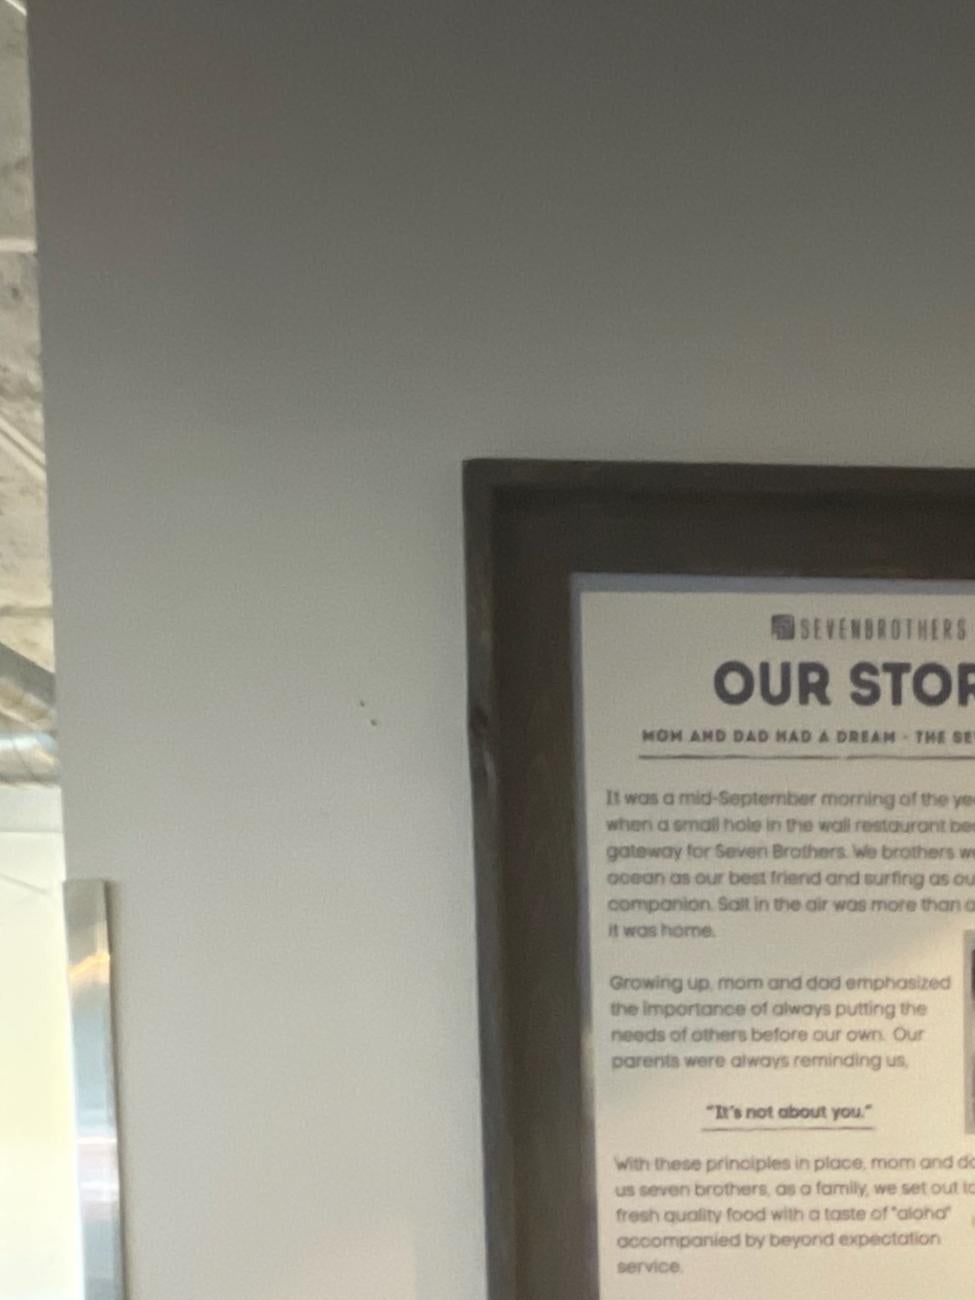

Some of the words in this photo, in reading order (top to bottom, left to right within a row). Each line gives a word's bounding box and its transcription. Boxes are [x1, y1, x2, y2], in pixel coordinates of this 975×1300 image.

[801, 617, 967, 641] SEVENBROTHERS
[714, 661, 831, 706] OUR
[642, 729, 683, 742] MOM
[690, 729, 726, 742] AND
[733, 730, 769, 743] DAD
[776, 730, 812, 743] HAD
[818, 730, 830, 743] A
[836, 730, 896, 743] DREAM
[916, 730, 945, 744] THE
[606, 790, 620, 806] It
[624, 793, 659, 805] was
[663, 793, 675, 805] a
[678, 790, 816, 810] mid-September
[821, 792, 896, 811] morning
[899, 791, 917, 806] of
[920, 792, 949, 807] the
[606, 845, 682, 863] gateway
[686, 844, 711, 859] for
[714, 843, 768, 859] Seven
[852, 845, 878, 859] We
[881, 845, 955, 860] brothers
[607, 872, 666, 885] ocean
[669, 873, 691, 885] as
[694, 872, 724, 885] our
[728, 871, 767, 885] best
[770, 871, 822, 886] friend
[825, 871, 861, 886] and
[864, 871, 925, 890] surfing
[929, 873, 950, 886] as
[609, 975, 683, 994] Growing
[718, 977, 764, 990] mom
[767, 976, 803, 990] and
[806, 976, 841, 991] dad
[845, 976, 951, 996] emphasized
[610, 1002, 639, 1016] the
[642, 1000, 746, 1020] importance
[750, 1001, 768, 1016] of
[772, 1002, 831, 1020] always
[835, 1001, 896, 1020] putting
[900, 1002, 927, 1016] the
[611, 1028, 666, 1043] needs
[669, 1027, 688, 1042] of
[691, 1028, 747, 1042] others
[751, 1027, 808, 1042] before
[813, 1029, 841, 1042] our
[893, 1026, 924, 1042] Our
[611, 1055, 680, 1071] parents
[684, 1056, 726, 1067] were
[730, 1055, 790, 1071] always
[793, 1053, 882, 1071] reminding
[746, 1106, 773, 1119] not
[778, 1105, 827, 1119] about
[614, 1157, 650, 1171] With
[654, 1158, 702, 1171] these
[706, 1156, 791, 1174] principles
[795, 1157, 810, 1170] in
[871, 1157, 916, 1169] mom
[919, 1155, 954, 1170] and
[616, 1208, 660, 1223] fresh
[663, 1208, 722, 1226] quality
[726, 1207, 767, 1222] food
[770, 1207, 804, 1221] with
[808, 1209, 820, 1221] a
[824, 1208, 866, 1221] taste
[870, 1206, 888, 1221] of
[617, 1234, 741, 1249] accompanied
[745, 1233, 766, 1249] by
[769, 1233, 835, 1249] beyond
[838, 1232, 941, 1248] expectation
